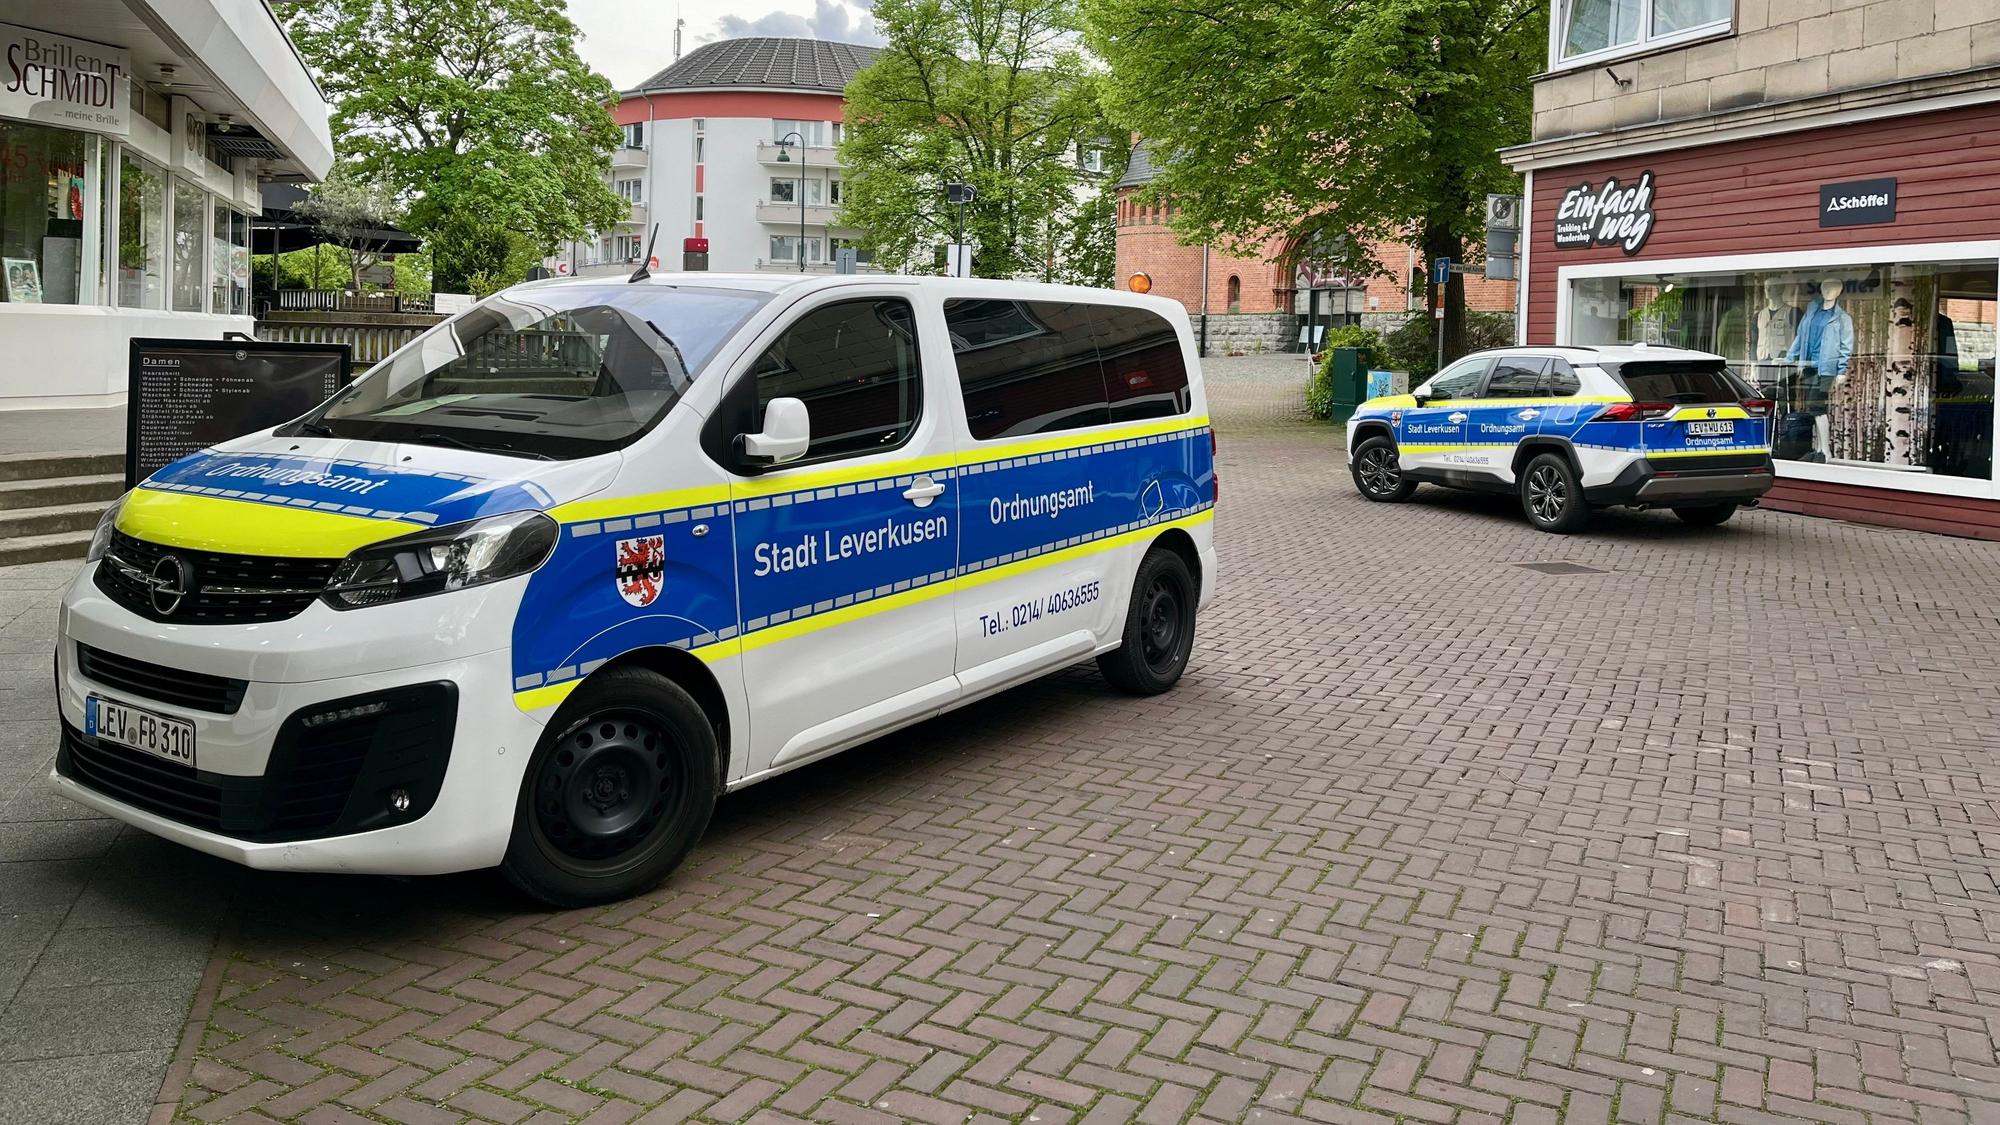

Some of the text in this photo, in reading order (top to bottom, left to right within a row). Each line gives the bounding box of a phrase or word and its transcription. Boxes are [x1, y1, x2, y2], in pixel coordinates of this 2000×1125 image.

[24, 37, 101, 73] Brillen
[7, 43, 121, 109] SCHMIDT
[65, 110, 93, 122] meine
[96, 113, 120, 126] Brille
[1558, 173, 1651, 229] Einfach
[1839, 193, 1889, 209] Schöffel
[1582, 222, 1588, 231] &
[1598, 213, 1651, 251] weg
[142, 357, 180, 365] Damen
[1408, 423, 1460, 434] Stadt Leverkusen
[1481, 423, 1525, 435] Ordnungsamt
[1685, 436, 1734, 446] Ordnungsamt
[1689, 423, 1703, 433] LEV
[1719, 422, 1733, 432] 613
[205, 462, 389, 495] Ordnungsamt
[990, 480, 1095, 524] Ordnungsamt
[753, 515, 948, 577] Stadt Leverkusen
[980, 615, 1009, 638] Tel.:
[1047, 581, 1100, 616] 40636555
[97, 703, 191, 760] LEV FB 310
